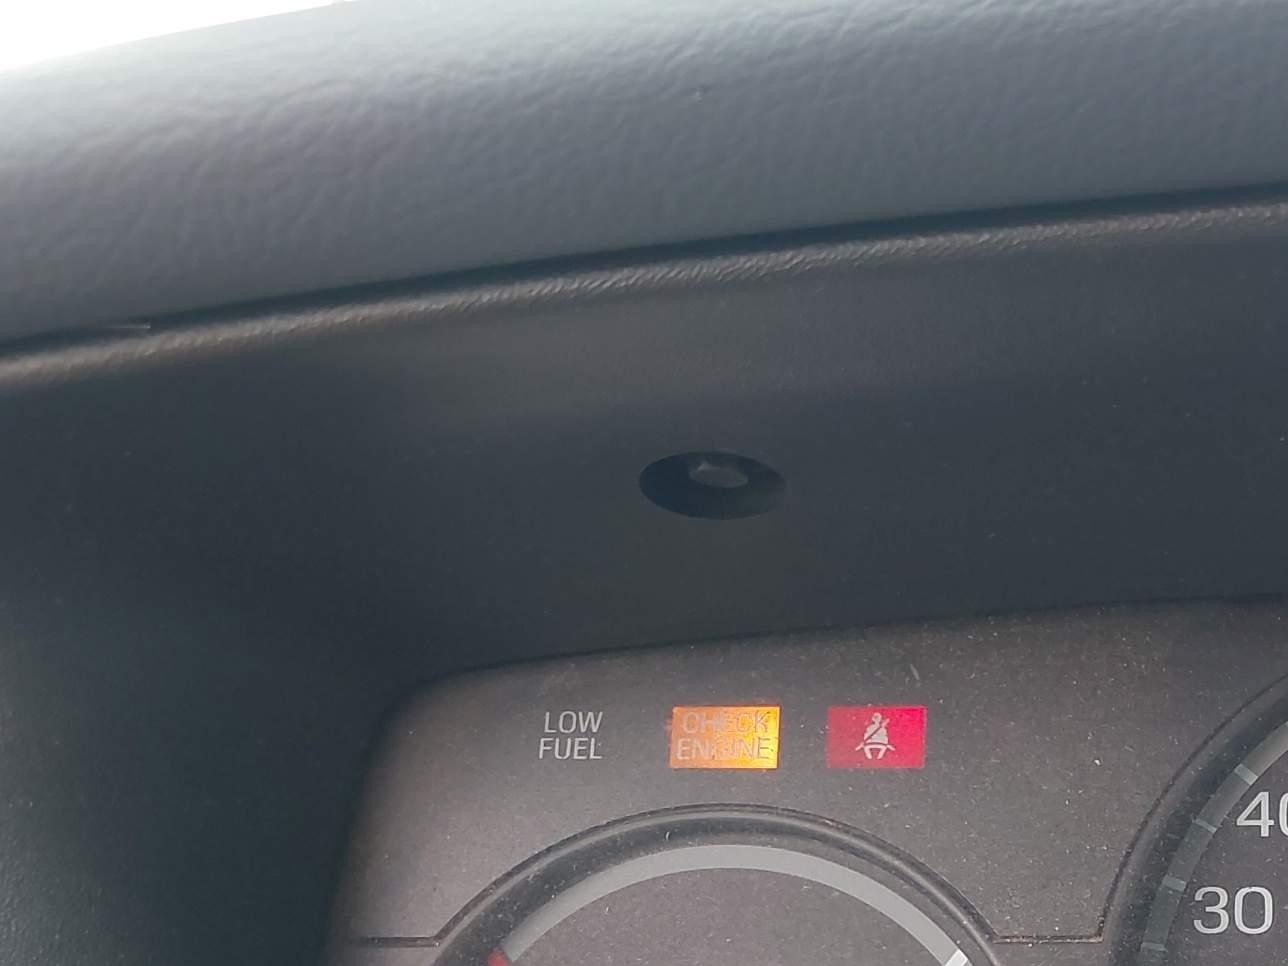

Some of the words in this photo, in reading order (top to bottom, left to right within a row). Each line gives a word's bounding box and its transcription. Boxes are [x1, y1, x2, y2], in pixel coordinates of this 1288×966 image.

[544, 711, 603, 733] LOW
[682, 711, 770, 731] CHECK
[538, 738, 603, 761] FUEL
[675, 737, 771, 760] ENGINE
[1193, 886, 1273, 934] 30
